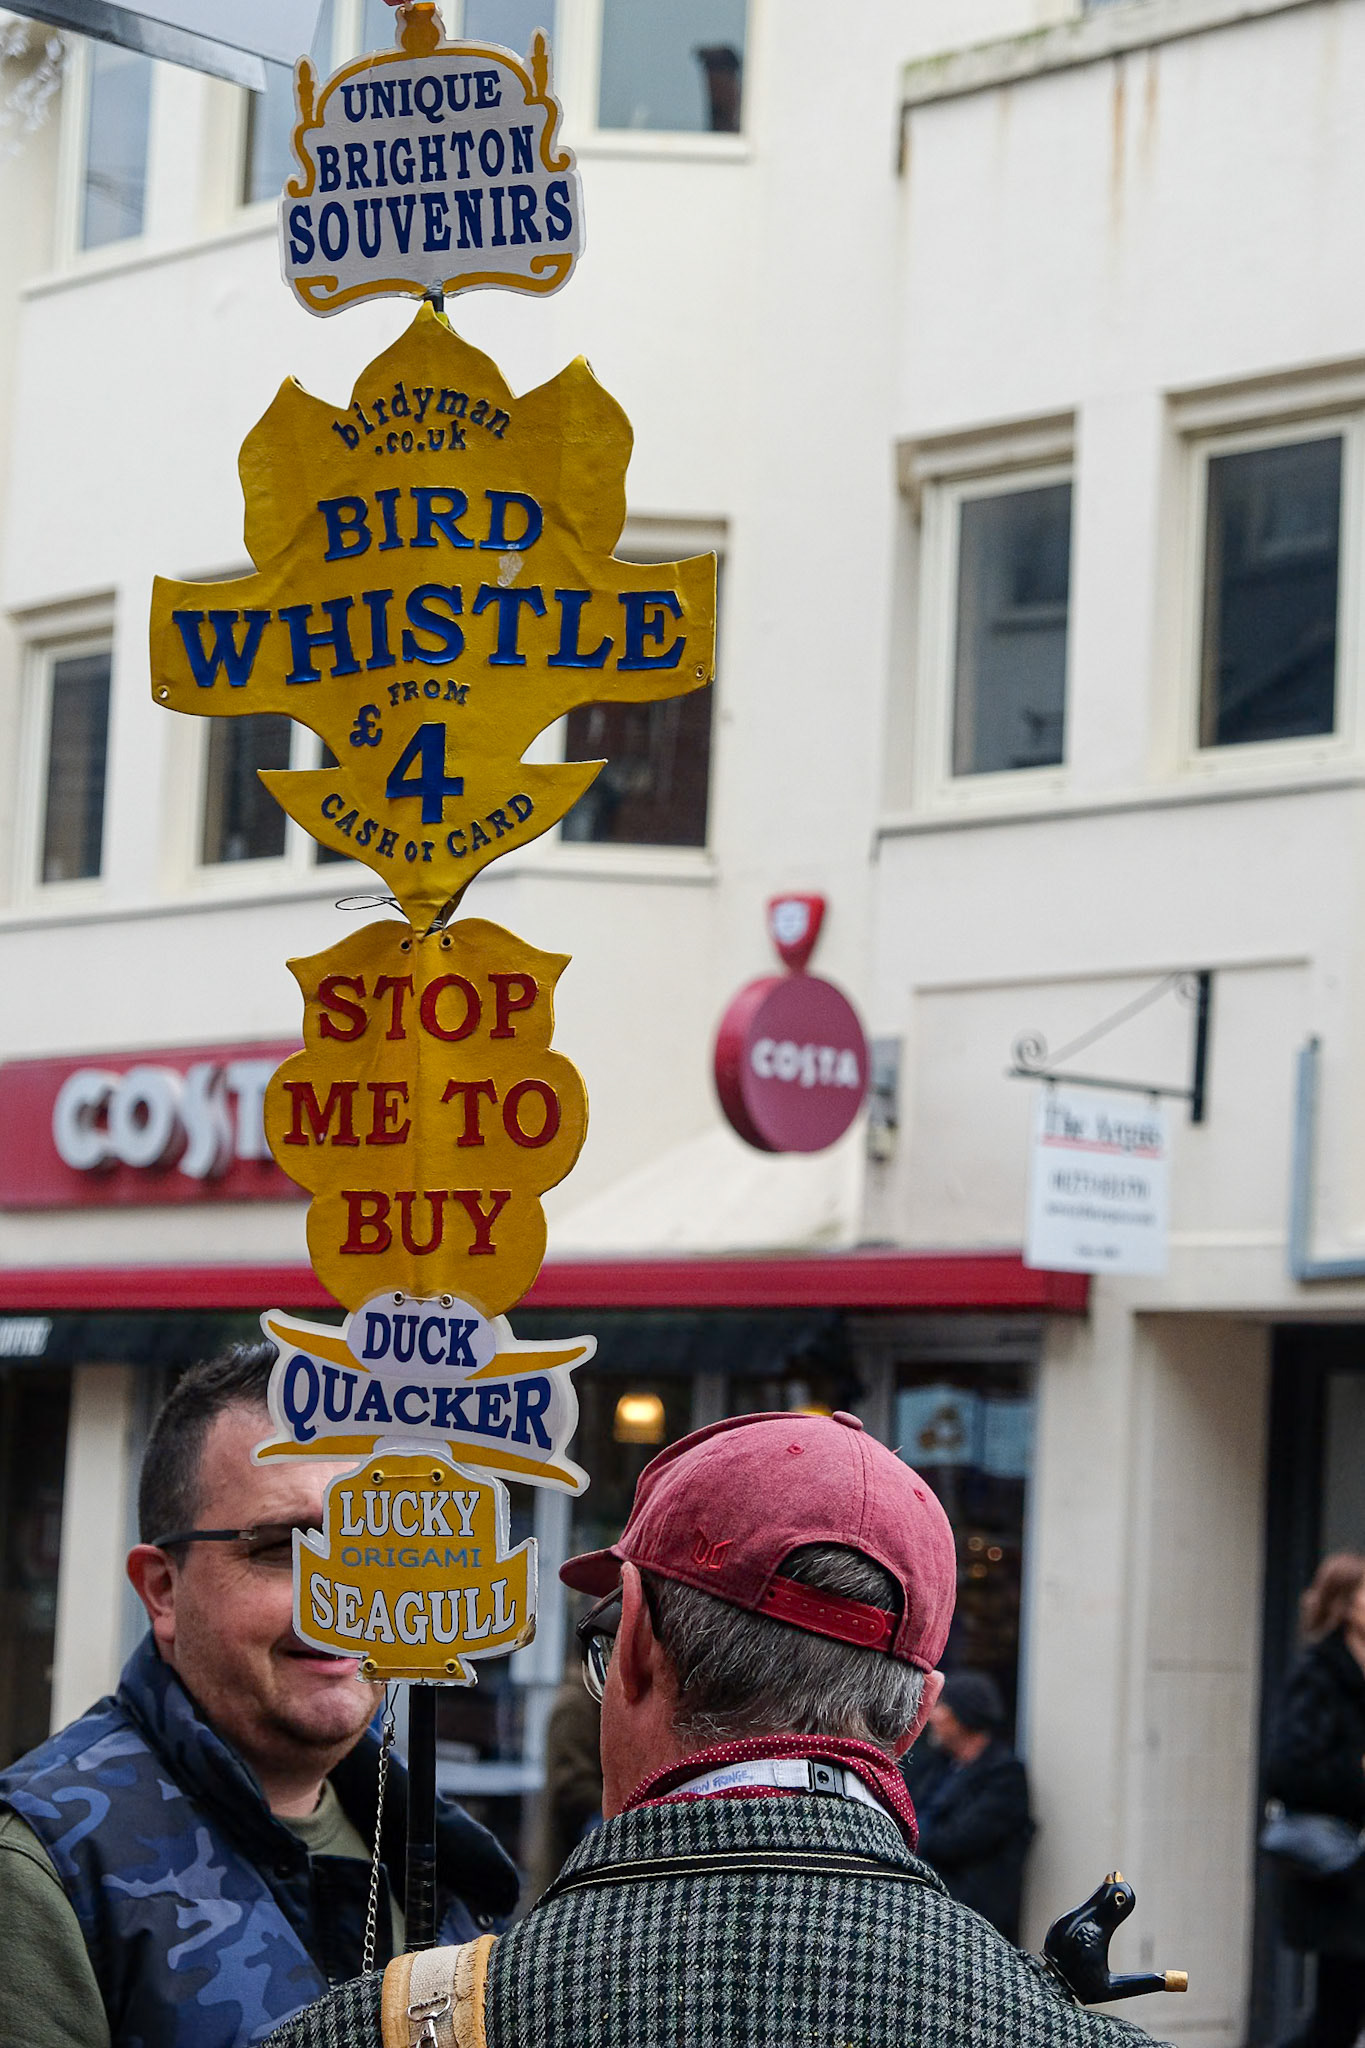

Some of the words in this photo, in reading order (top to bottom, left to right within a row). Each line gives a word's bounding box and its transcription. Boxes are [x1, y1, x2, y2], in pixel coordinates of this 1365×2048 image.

[341, 69, 502, 123] UNIQUE
[316, 125, 534, 193] BRIGHTON
[288, 180, 573, 264] SOUVENIRS
[332, 380, 512, 450] birdyman
[375, 419, 467, 455] .co.uk
[317, 486, 544, 562] BIRD
[172, 583, 689, 688] WHISTLE
[387, 679, 471, 707] FROM
[321, 793, 400, 859] CASH
[404, 840, 435, 863] or
[446, 792, 535, 858] CARD
[317, 973, 540, 1042] STOP
[750, 1036, 860, 1089] COSTA
[283, 1080, 413, 1147] ME
[441, 1077, 562, 1149] TO
[339, 1189, 513, 1256] BUY
[361, 1312, 479, 1368] DUCK
[283, 1354, 553, 1451] QUACKER
[339, 1490, 481, 1537] LUCKY
[341, 1546, 483, 1569] ORIGAMI
[309, 1572, 517, 1646] SEAGULL
